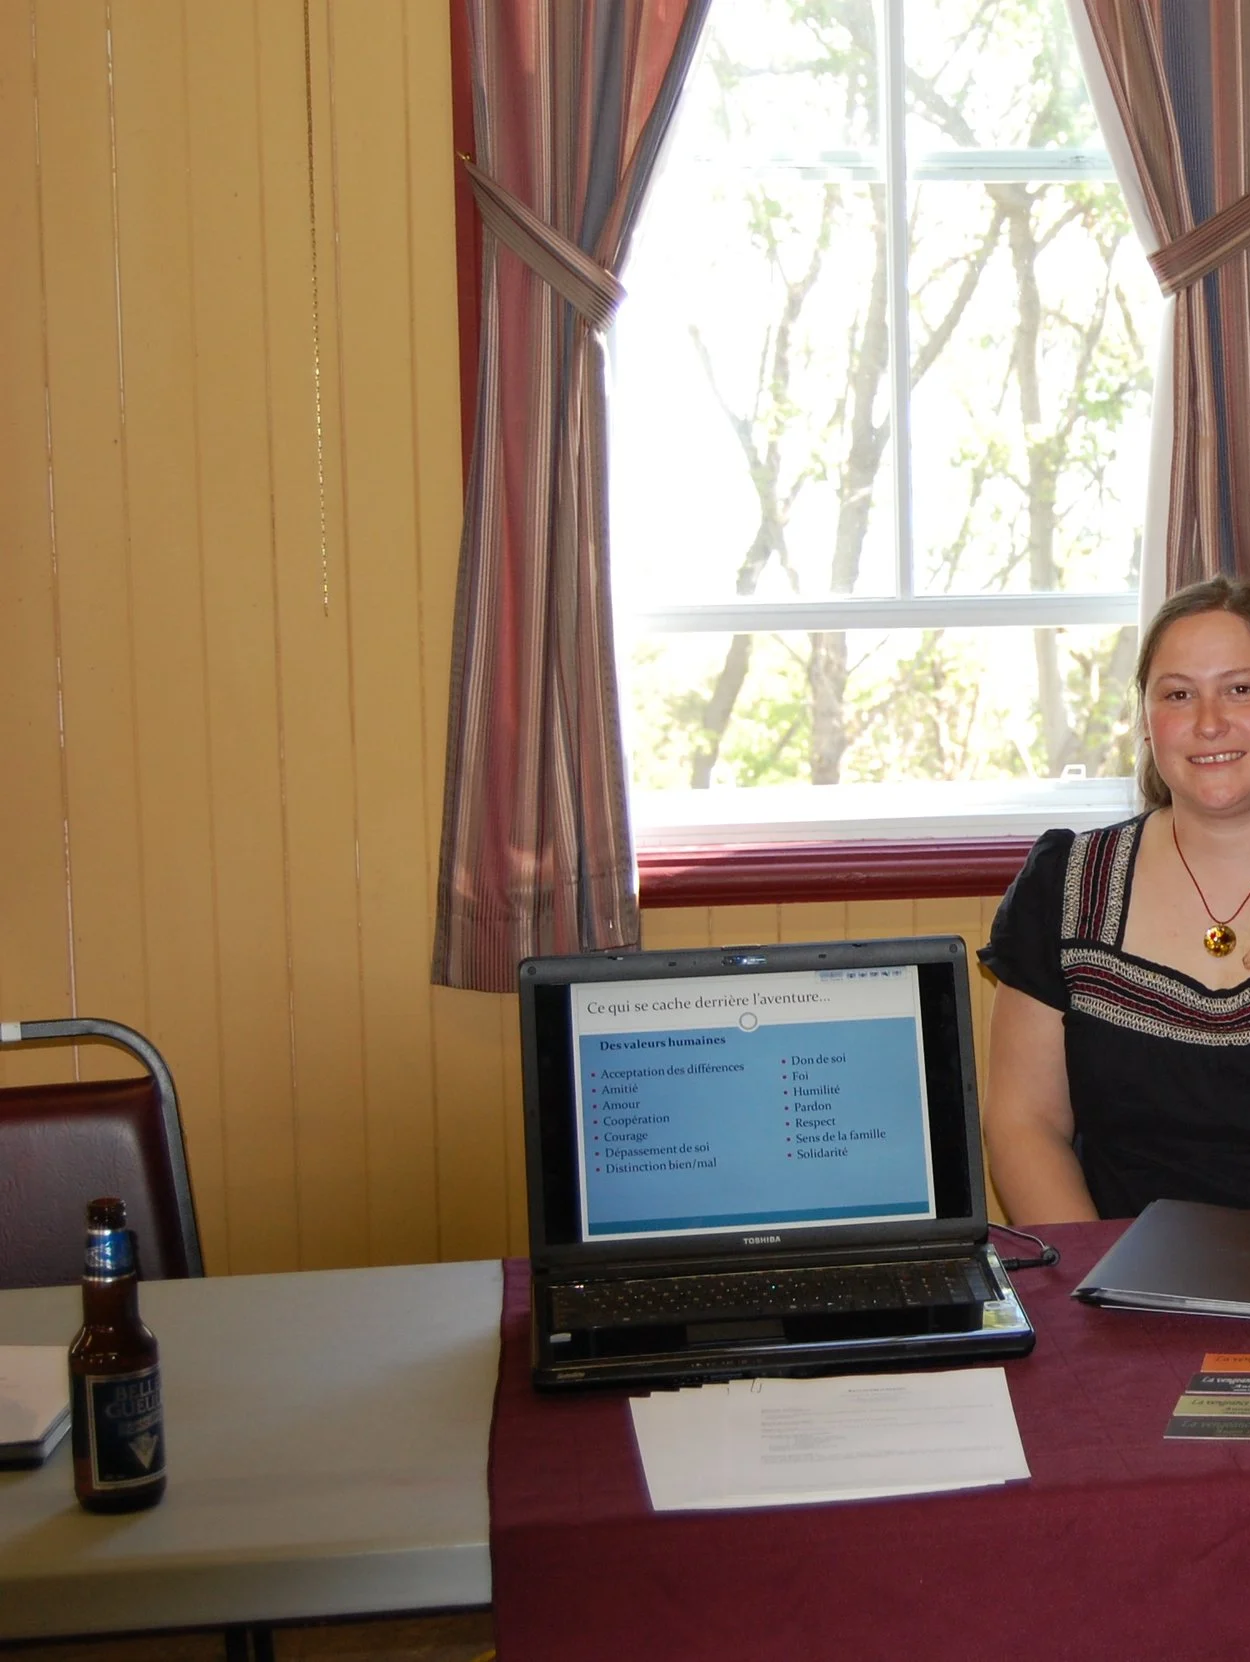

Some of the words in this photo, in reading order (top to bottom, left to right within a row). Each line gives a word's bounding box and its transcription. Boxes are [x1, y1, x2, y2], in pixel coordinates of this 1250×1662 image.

[587, 1001, 605, 1014] Ce
[608, 1000, 630, 1016] qui
[634, 1001, 649, 1012] se
[652, 997, 691, 1011] cache
[695, 995, 749, 1008] derrière
[753, 992, 831, 1005] l'aventure...
[600, 1041, 621, 1051] Des
[623, 1039, 666, 1050] valeurs
[668, 1036, 726, 1048] humaines
[791, 1055, 814, 1066] Don
[816, 1054, 829, 1064] de
[831, 1052, 846, 1063] soi
[600, 1066, 665, 1080] Acceptation
[667, 1065, 685, 1076] des
[687, 1063, 745, 1075] différences
[792, 1071, 809, 1081] Foi
[601, 1084, 639, 1095] Amitié
[793, 1084, 840, 1096] Humilité
[602, 1100, 641, 1111] Amour
[794, 1101, 832, 1112] Pardon
[603, 1114, 670, 1128] Coopération
[795, 1117, 836, 1129] Respect
[604, 1132, 649, 1143] Courage
[796, 1133, 820, 1144] Sens
[822, 1132, 836, 1142] de
[838, 1131, 847, 1141] la
[849, 1128, 886, 1141] famille
[605, 1145, 677, 1160] Dépassement
[679, 1143, 692, 1154] de
[694, 1142, 710, 1153] soi
[797, 1147, 849, 1159] Solidarité
[606, 1161, 666, 1174] Distinction
[668, 1157, 717, 1171] bien/mal
[743, 1235, 781, 1245] TOSHIBA
